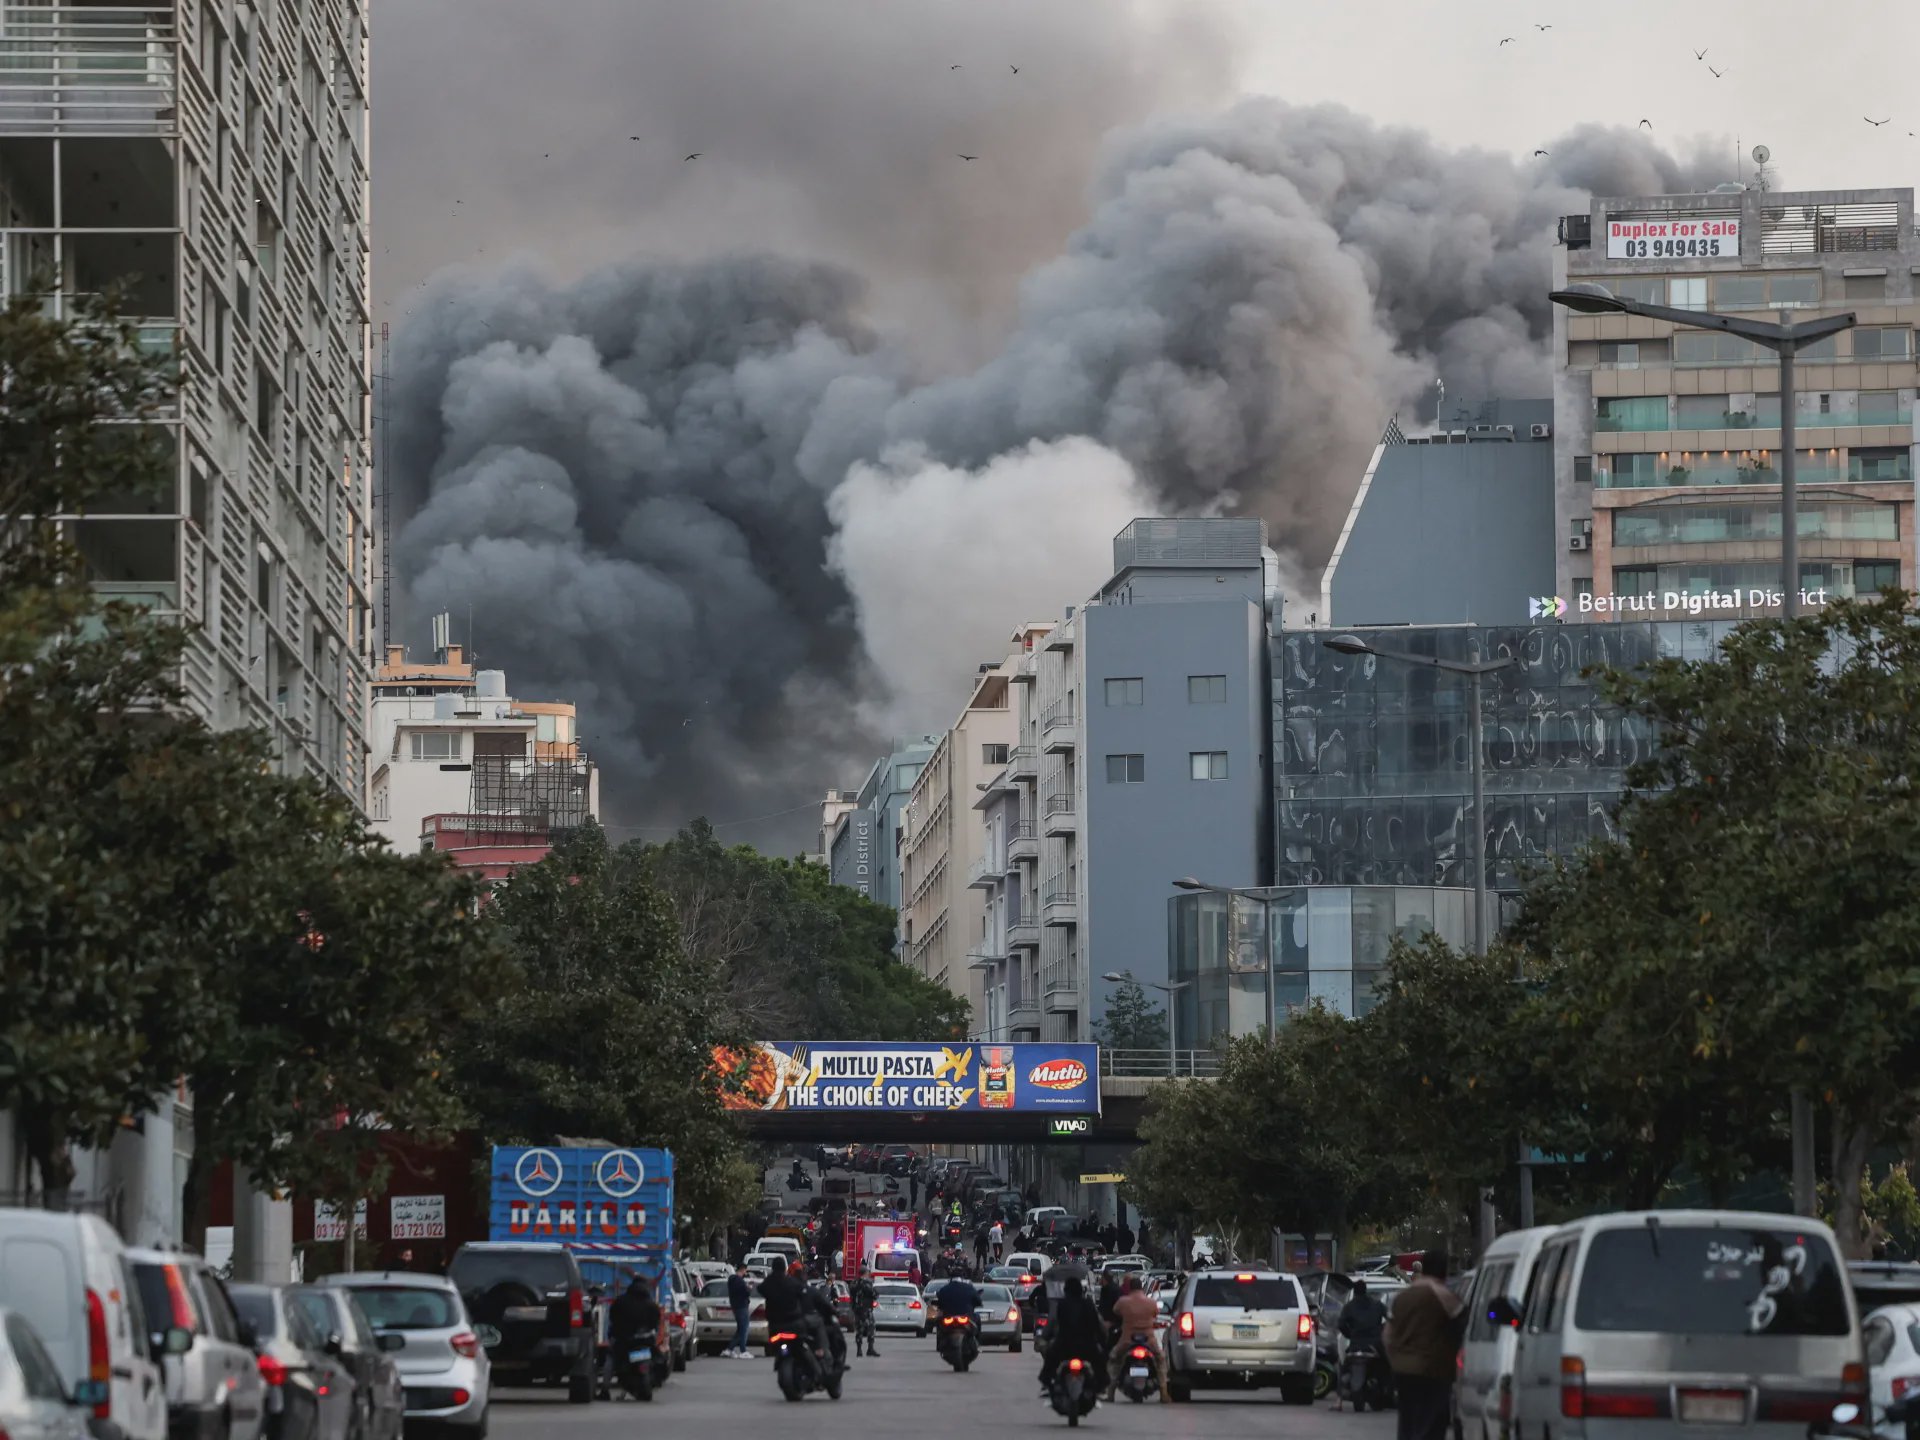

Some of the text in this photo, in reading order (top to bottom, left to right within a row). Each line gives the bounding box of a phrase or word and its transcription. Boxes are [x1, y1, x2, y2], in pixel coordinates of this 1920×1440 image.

[1612, 221, 1737, 239] Duplex For Sale
[1626, 239, 1720, 257] 03 949435
[1579, 588, 1827, 614] Beirut Digital Disict
[856, 822, 868, 874] District
[822, 1056, 935, 1075] MUTLU PASTA
[1030, 1064, 1083, 1083] Mutlu
[787, 1086, 818, 1106] THE
[823, 1086, 883, 1106] CHOICE
[887, 1086, 909, 1106] OF
[913, 1086, 964, 1107] CHEFS
[316, 1223, 327, 1238] 03
[394, 1222, 443, 1237] 03 723 022
